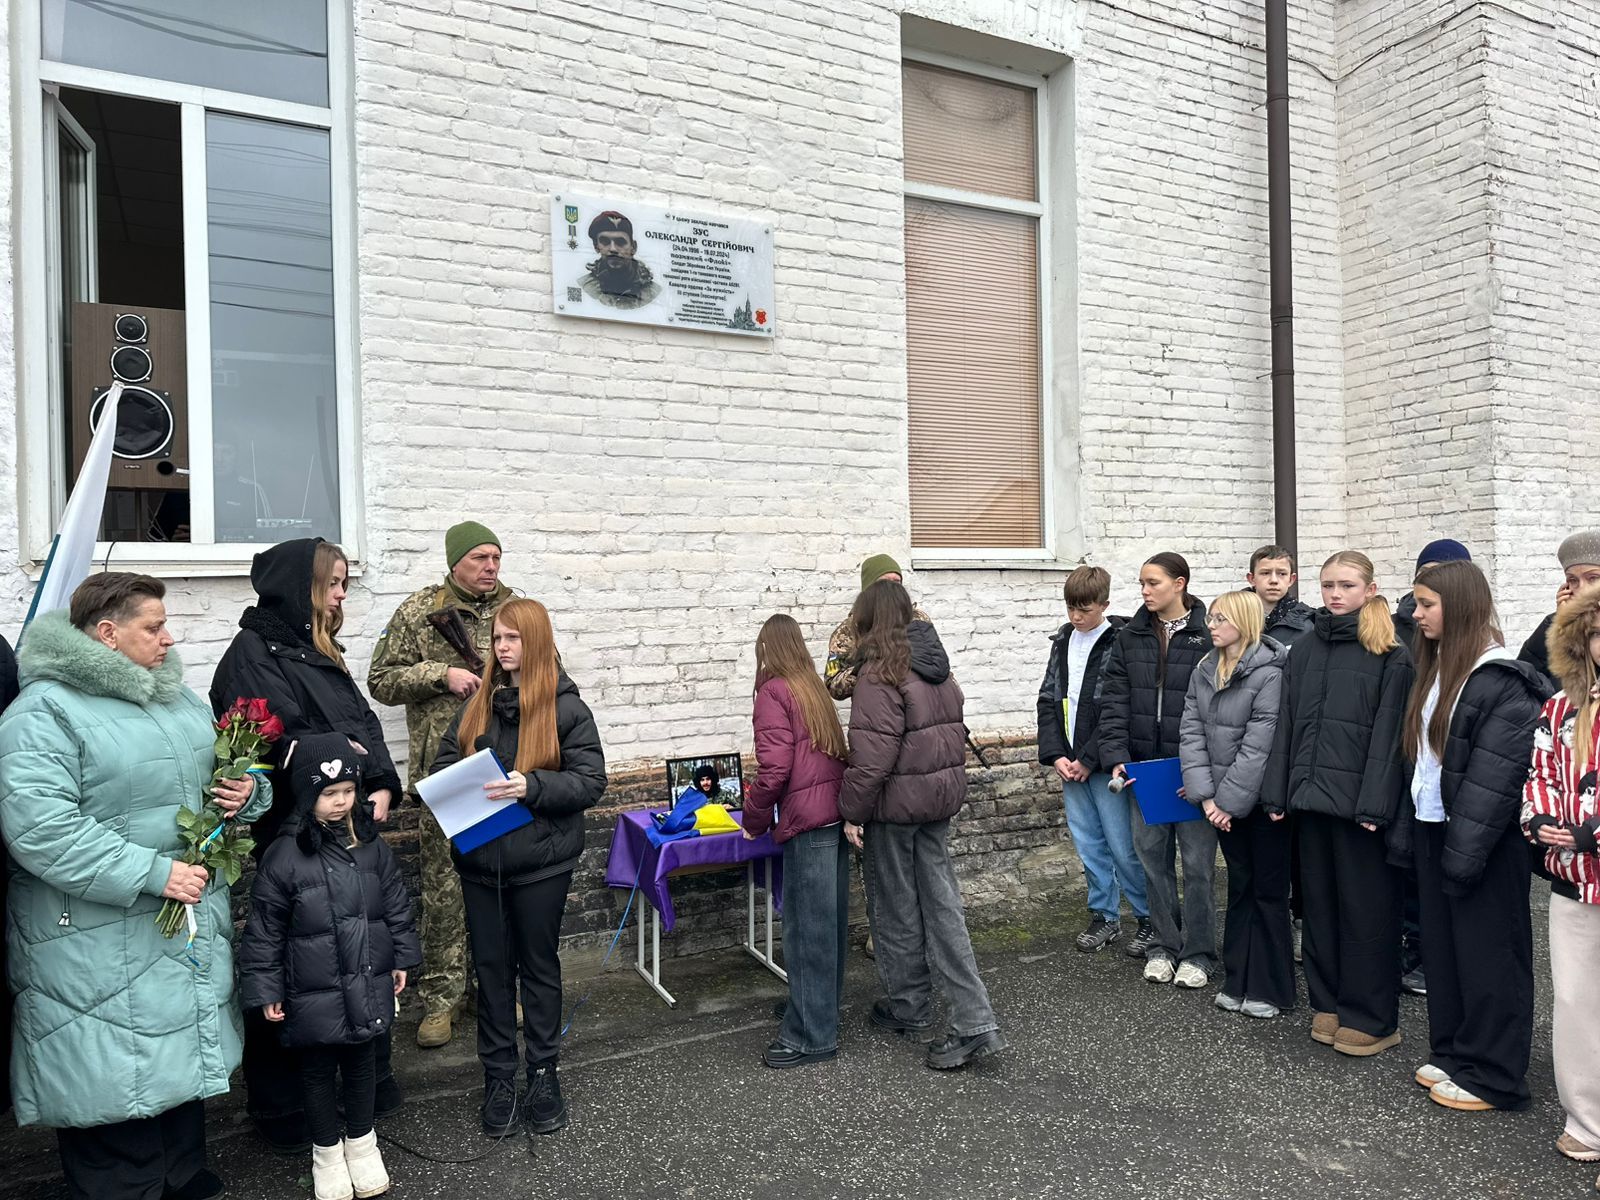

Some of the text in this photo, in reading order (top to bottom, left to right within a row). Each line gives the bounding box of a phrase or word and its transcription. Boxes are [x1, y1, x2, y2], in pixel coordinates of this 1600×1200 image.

[692, 227, 710, 237] ЗУС
[645, 230, 755, 253] ОЛЕКСАНДР СЕРГІЙОВИЧ
[670, 252, 703, 262] позивний
